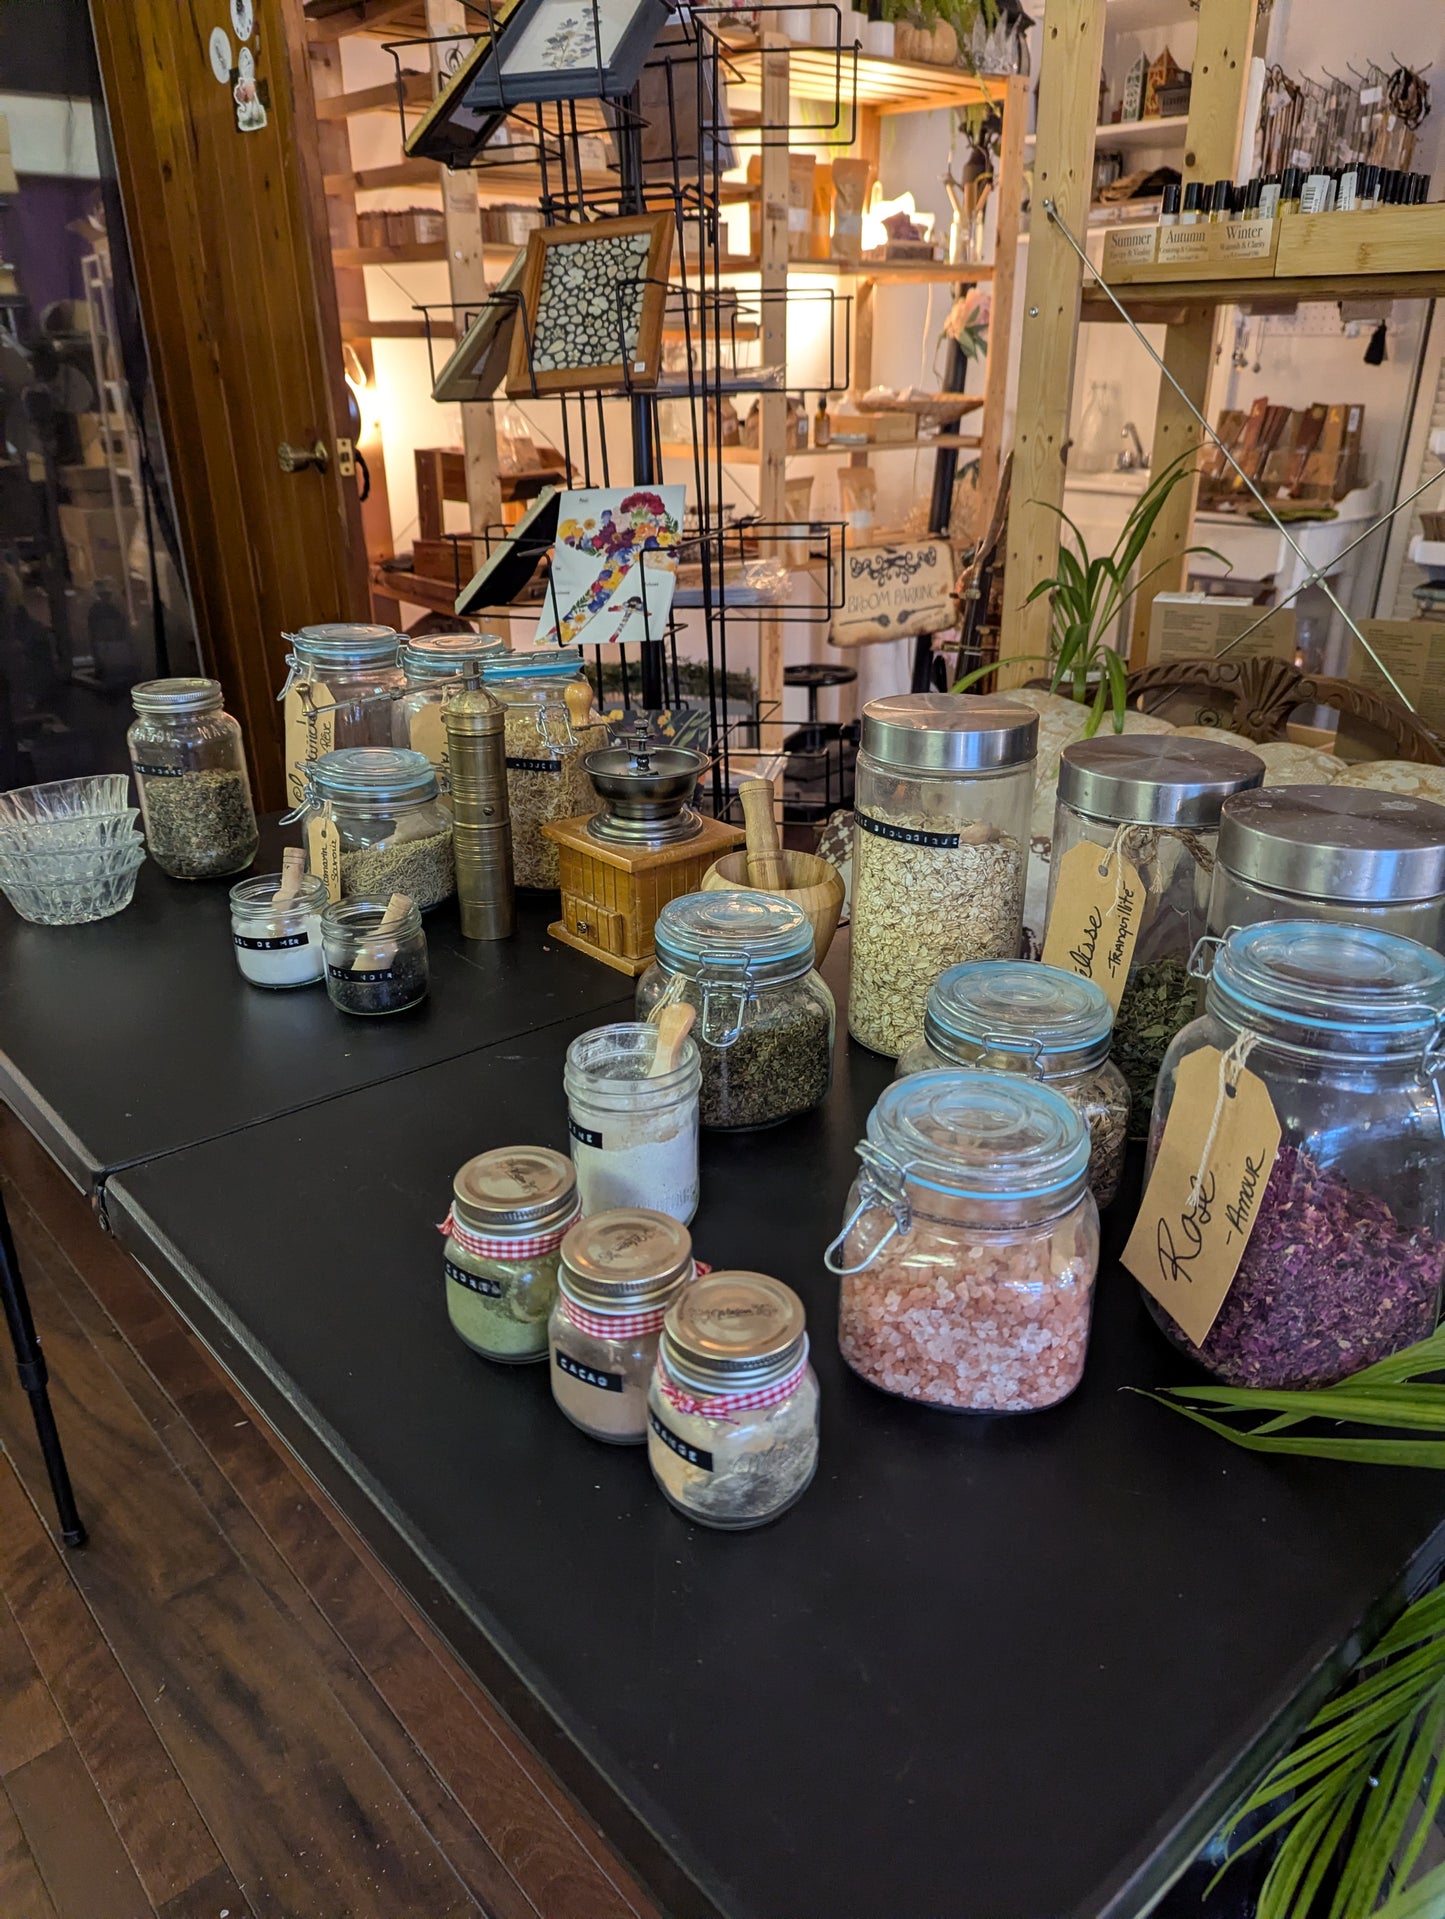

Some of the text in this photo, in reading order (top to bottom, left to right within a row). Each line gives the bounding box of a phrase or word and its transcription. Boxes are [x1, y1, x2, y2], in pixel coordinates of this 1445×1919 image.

[1166, 230, 1206, 244] Autumn
[1226, 224, 1264, 240] Winter
[1111, 233, 1152, 248] Summer
[894, 582, 939, 606] PARKING
[873, 824, 959, 846] BIOLOGIQUE
[234, 936, 300, 949] SEL DE MER
[332, 968, 394, 982] SEL NOIR
[560, 1357, 608, 1388] CACAO
[654, 1422, 698, 1464] RANGE
